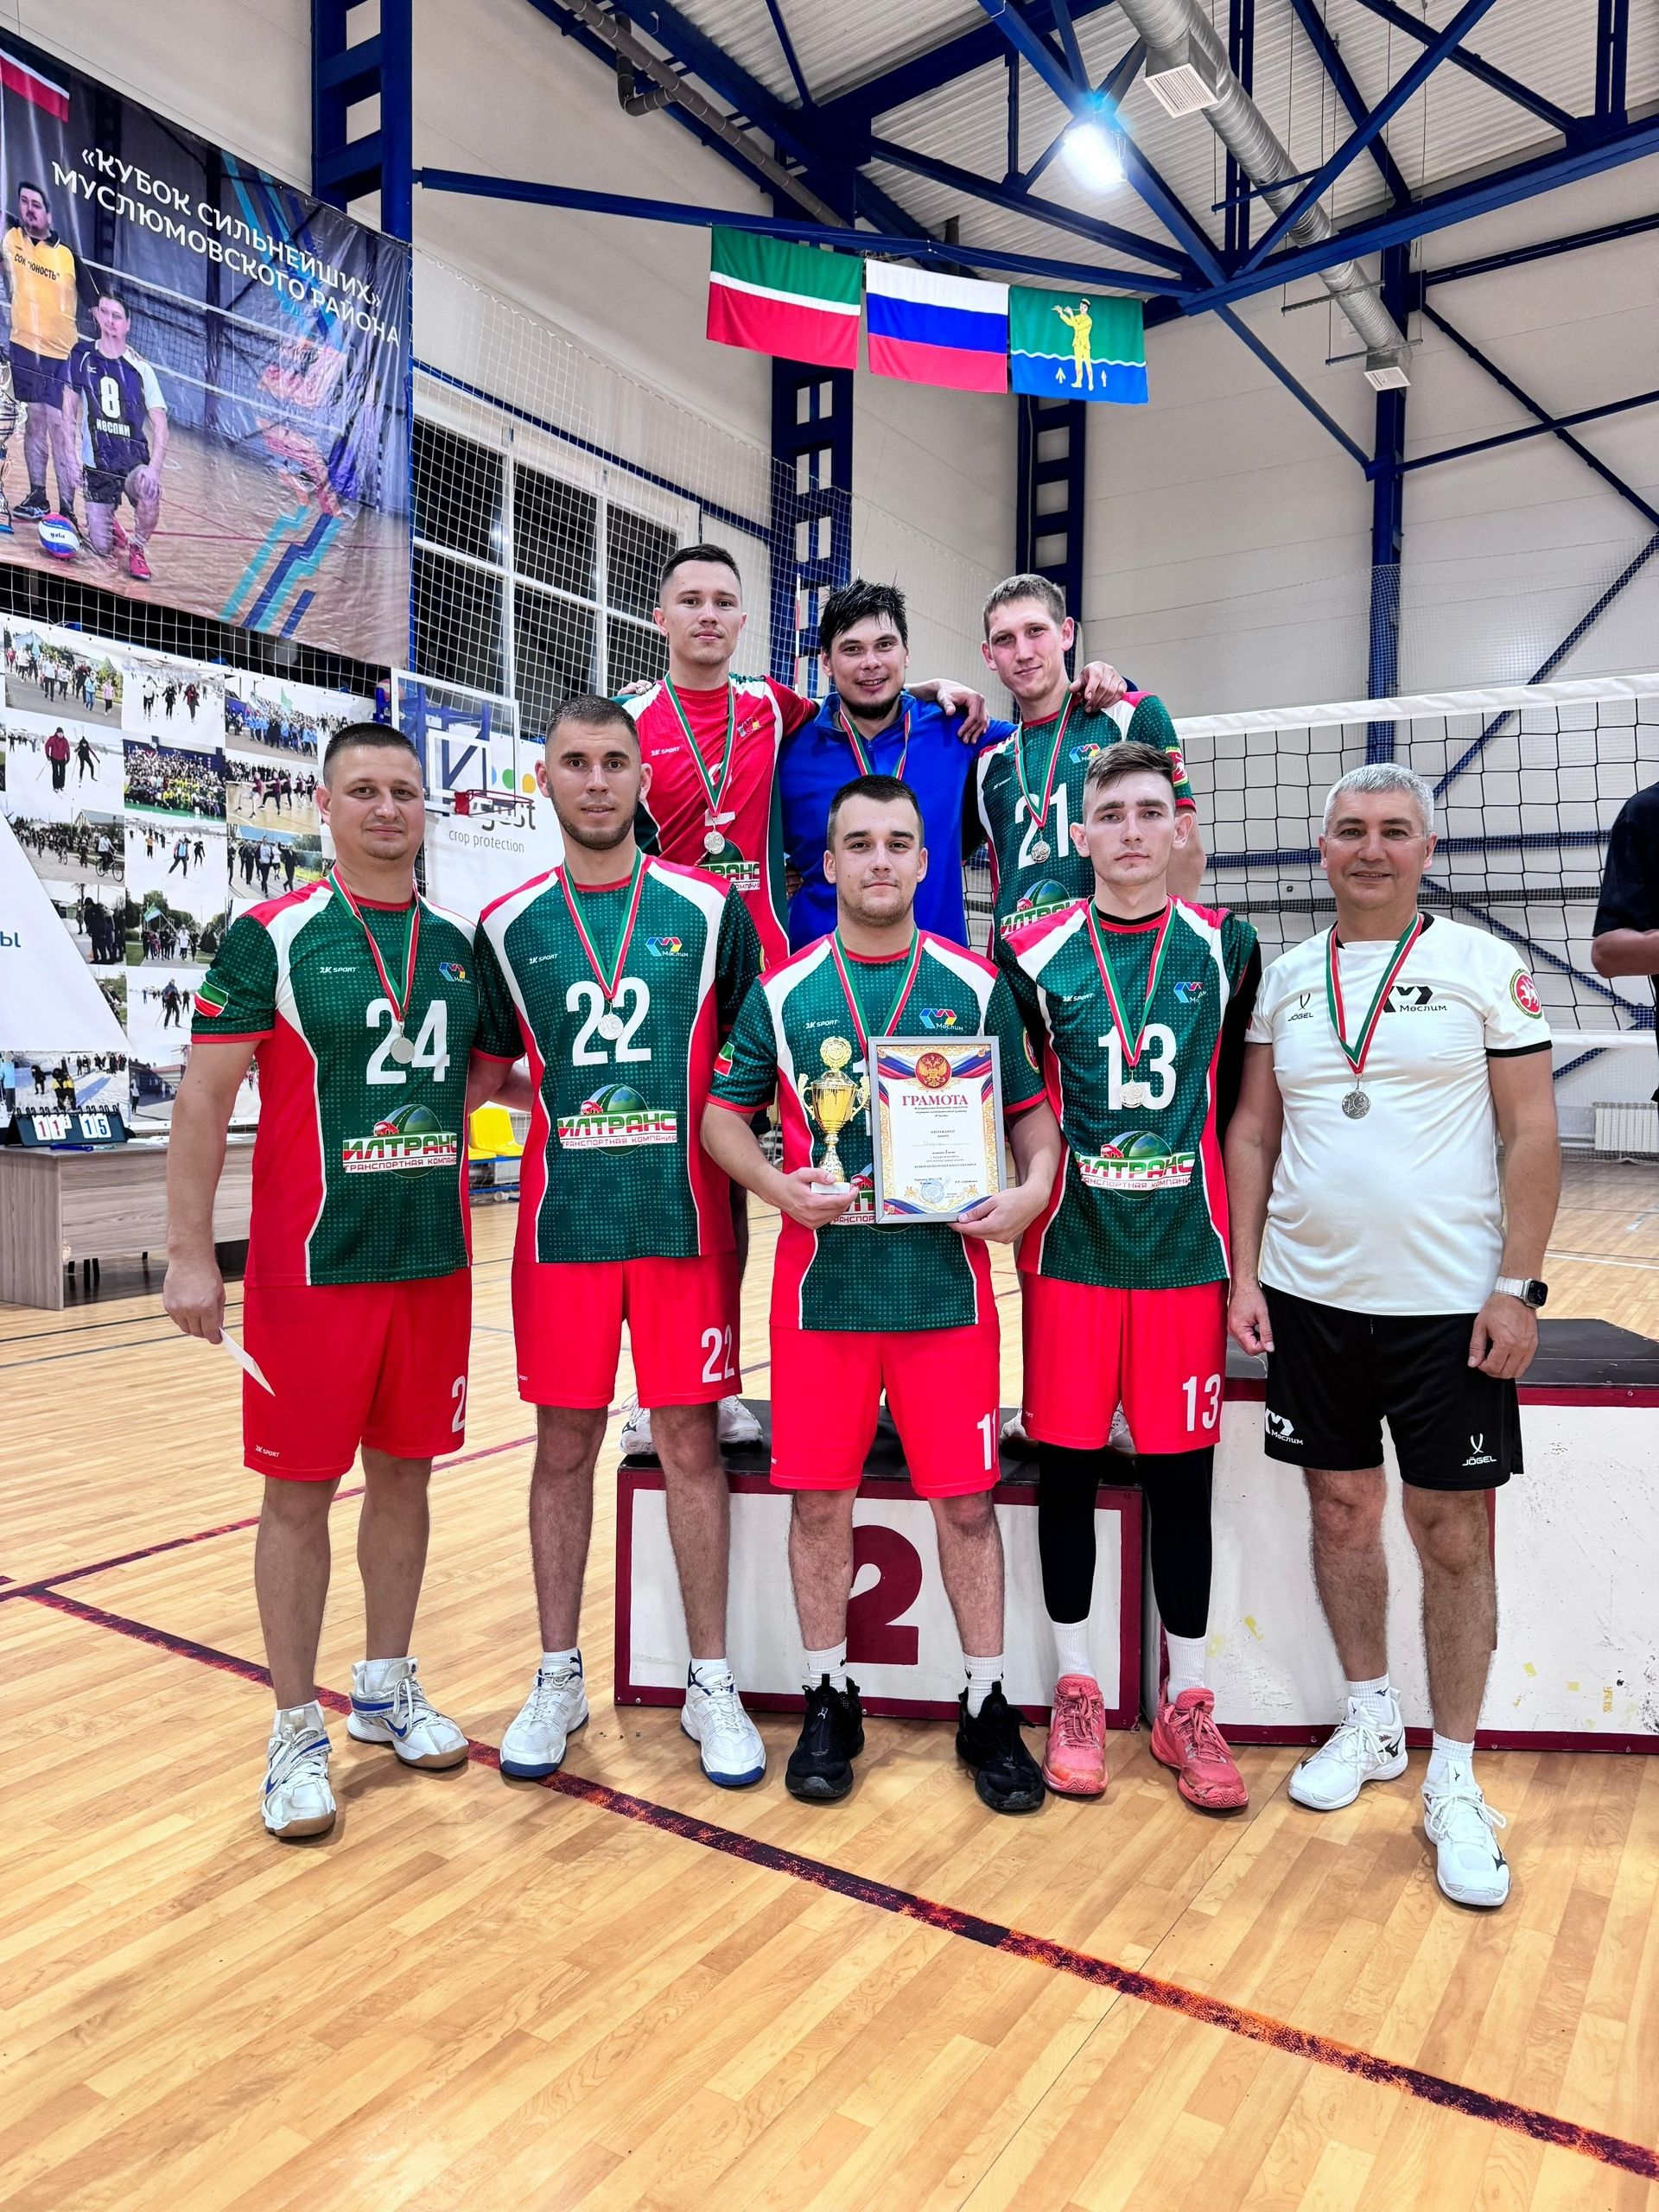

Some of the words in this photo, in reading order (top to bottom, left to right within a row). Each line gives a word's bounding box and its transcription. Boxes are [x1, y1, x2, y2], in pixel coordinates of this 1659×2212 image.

[81, 148, 192, 216] «КУБОК
[197, 202, 381, 308] СИЛЬНЕЙШИХ»
[52, 161, 305, 301] МУСЛЮМОВСКОГО
[311, 287, 400, 346] РАЙОНА
[99, 376, 121, 418] 8
[1015, 783, 1069, 869] 21
[448, 829, 470, 844] crop
[473, 834, 524, 853] protection
[528, 956, 538, 964] 2K
[537, 953, 559, 963] SPORT
[1072, 993, 1095, 1001] SPORT
[565, 976, 652, 1066] 22
[805, 1020, 817, 1029] 2K
[816, 1019, 839, 1027] SPORT
[366, 998, 450, 1085] 24
[1097, 1023, 1177, 1110] 13
[902, 1094, 969, 1106] ГРАМОТА
[84, 1118, 108, 1135] 15
[557, 1112, 677, 1138] ИЛТРАНС
[562, 1137, 627, 1147] ТРАНСПОРТНАЯ
[631, 1135, 677, 1143] КОМПАНИЯ
[345, 1159, 424, 1172] ТРАНСПОРТНАЯ
[833, 1214, 875, 1224] РАНСПОР
[701, 1325, 735, 1383] 22
[1182, 1373, 1221, 1432] 13
[976, 1408, 996, 1471] 1
[262, 1448, 281, 1458] SPORT
[1461, 1456, 1498, 1466] JÖGEL
[846, 1524, 923, 1666] 2
